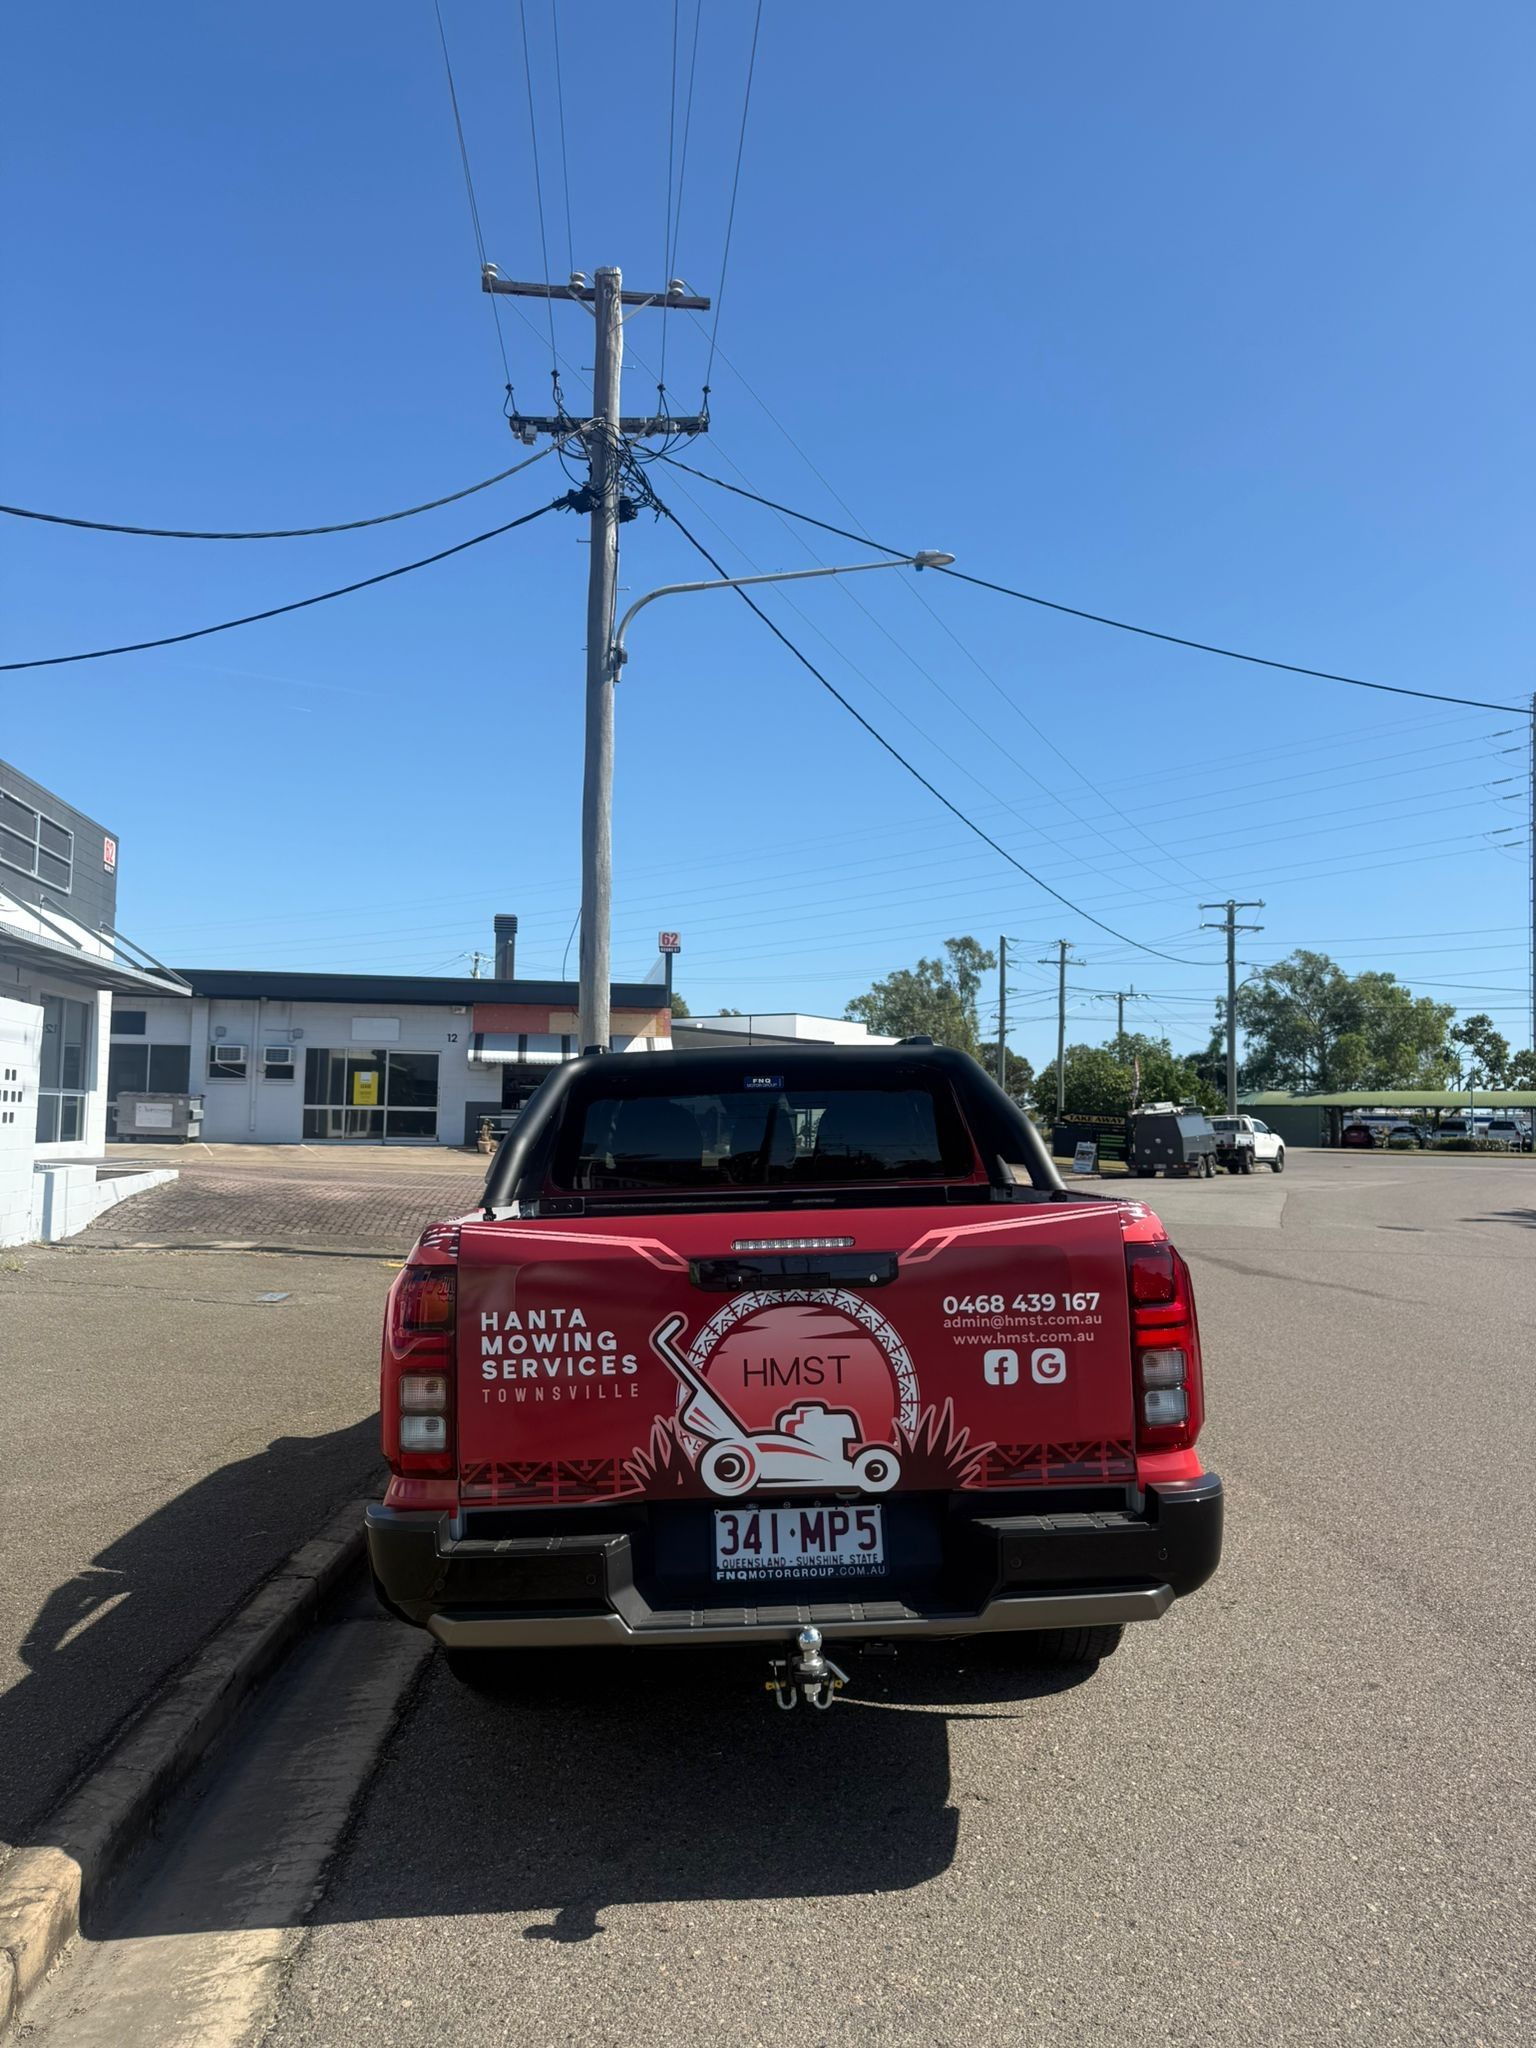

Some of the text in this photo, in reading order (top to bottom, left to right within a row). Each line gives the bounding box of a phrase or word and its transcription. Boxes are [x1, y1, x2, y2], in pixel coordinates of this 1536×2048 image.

[662, 932, 678, 946] 62
[447, 1033, 458, 1043] 12
[1095, 1116, 1123, 1124] AWAY
[943, 1292, 1100, 1314] 0468 439 167
[481, 1308, 587, 1331] HANTA
[943, 1314, 1102, 1329] admin@hmst.com.au
[481, 1331, 617, 1355] MOWING
[953, 1331, 1095, 1345] www.hmst.com.au
[482, 1354, 638, 1380] SERVICES
[743, 1355, 851, 1387] HMST
[482, 1383, 639, 1403] TOWNSVILLE
[722, 1556, 787, 1568] QUEENSLAND
[798, 1554, 844, 1565] SUNSHINE
[850, 1552, 879, 1564] STATE
[716, 1565, 886, 1581] FNQMOTORGROUP.COM.AU
